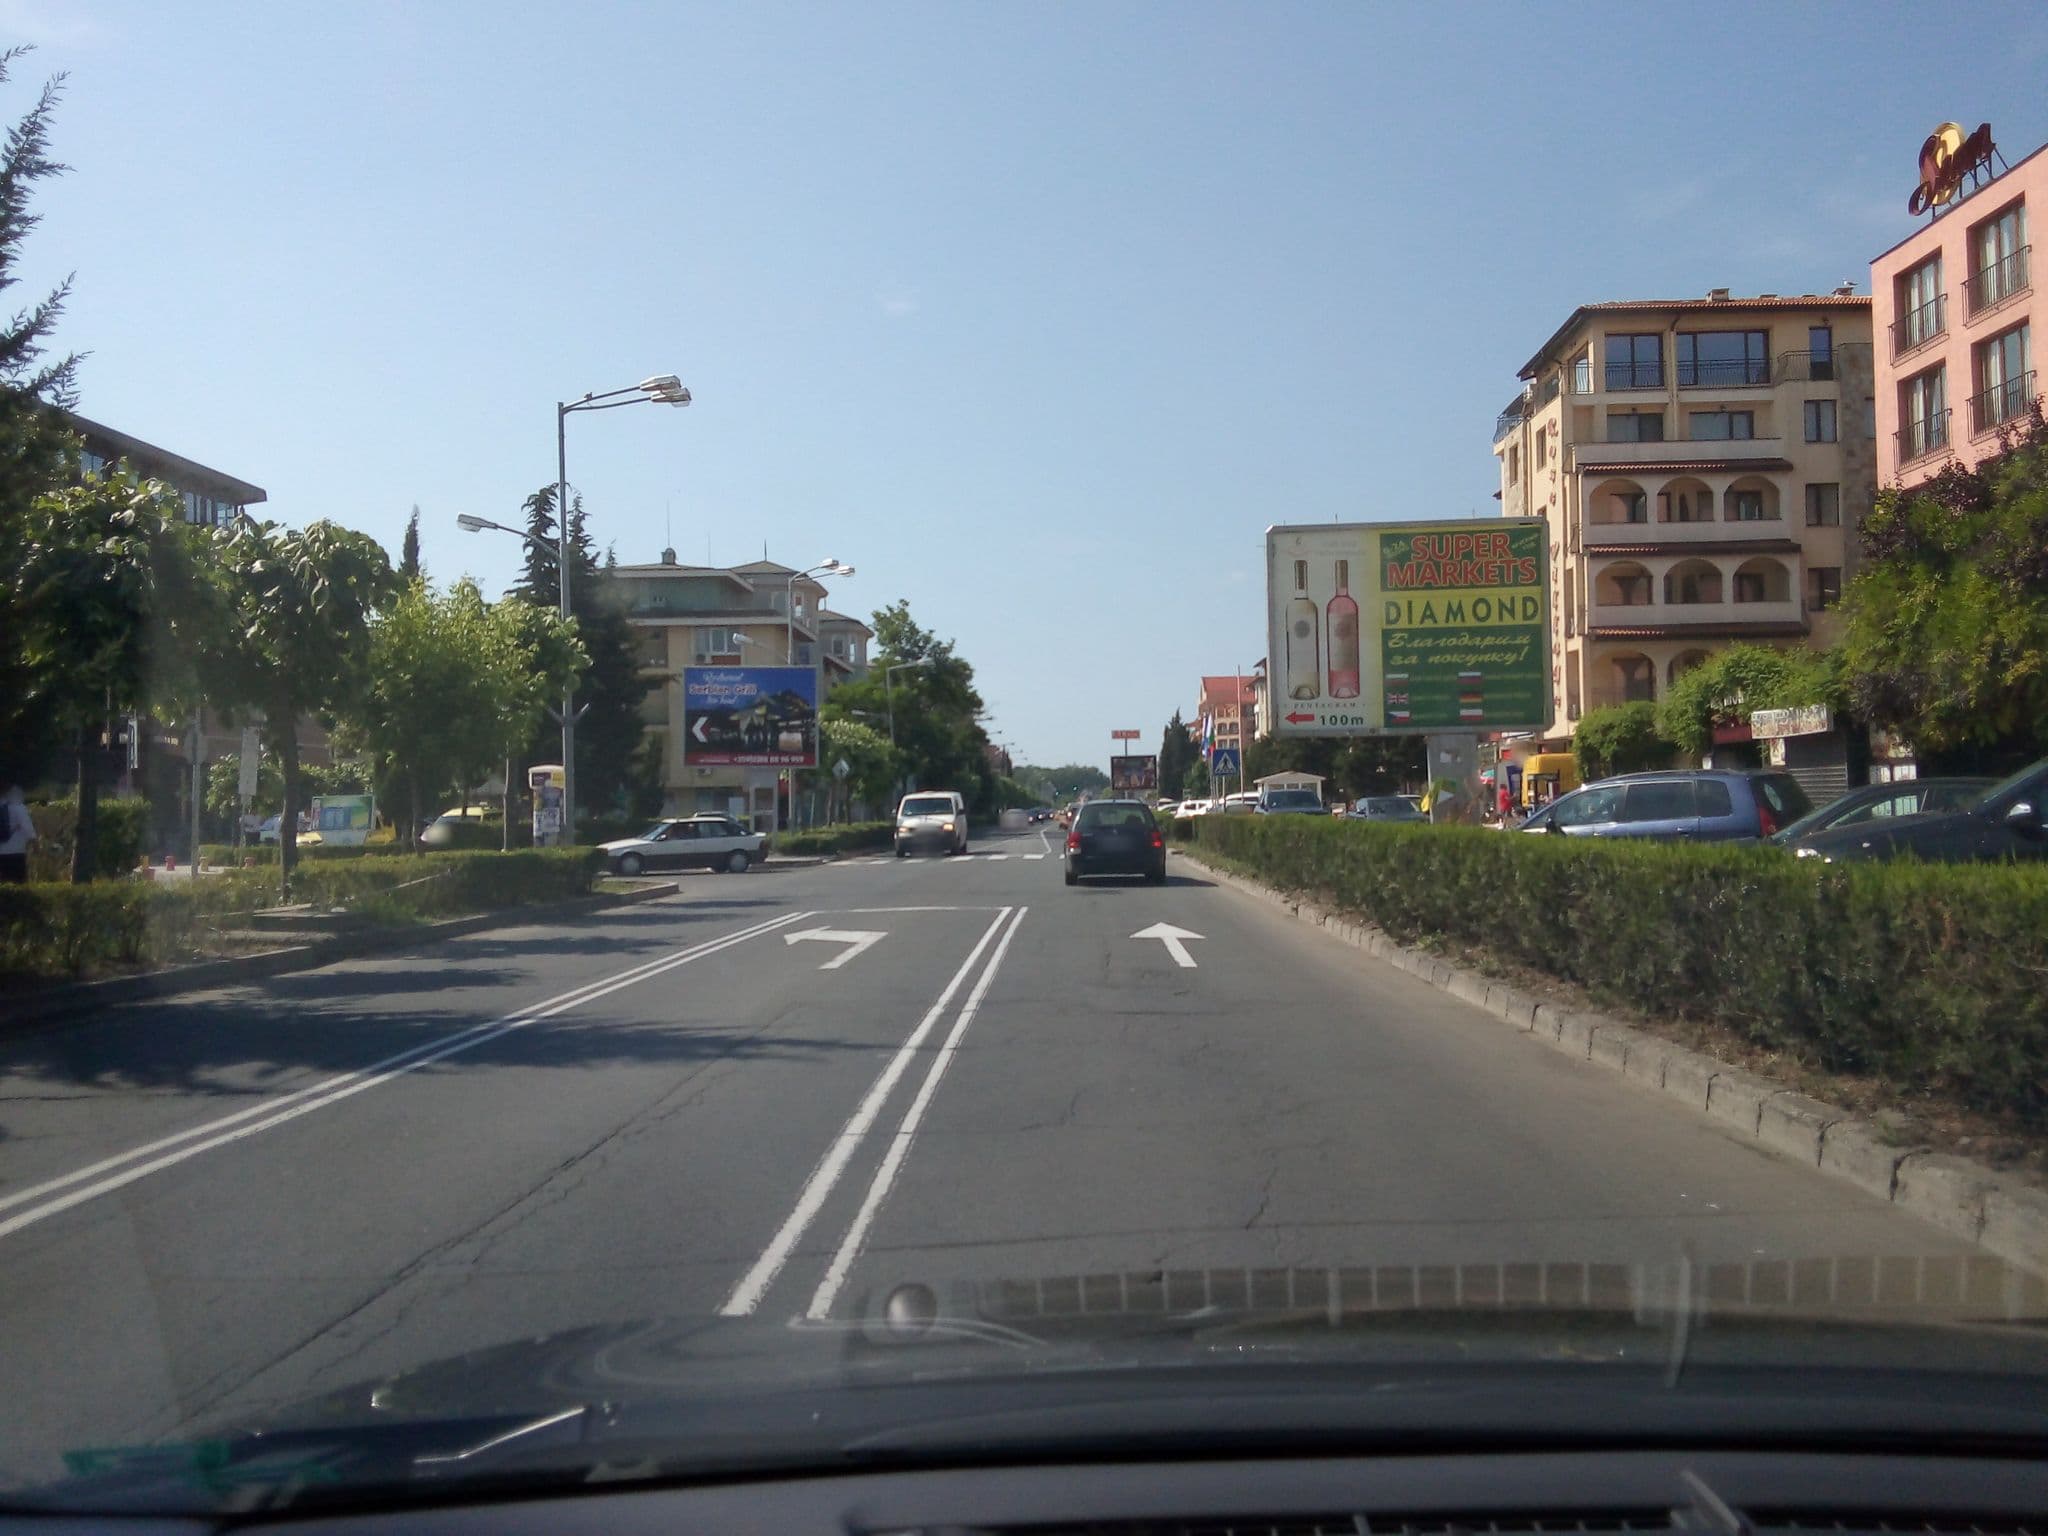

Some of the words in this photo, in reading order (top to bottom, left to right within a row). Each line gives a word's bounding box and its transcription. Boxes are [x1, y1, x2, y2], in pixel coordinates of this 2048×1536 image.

[1411, 533, 1512, 561] SUPER
[1387, 557, 1536, 588] MARKETS
[1384, 596, 1540, 625] DIAMOND
[1319, 713, 1365, 727] 100m
